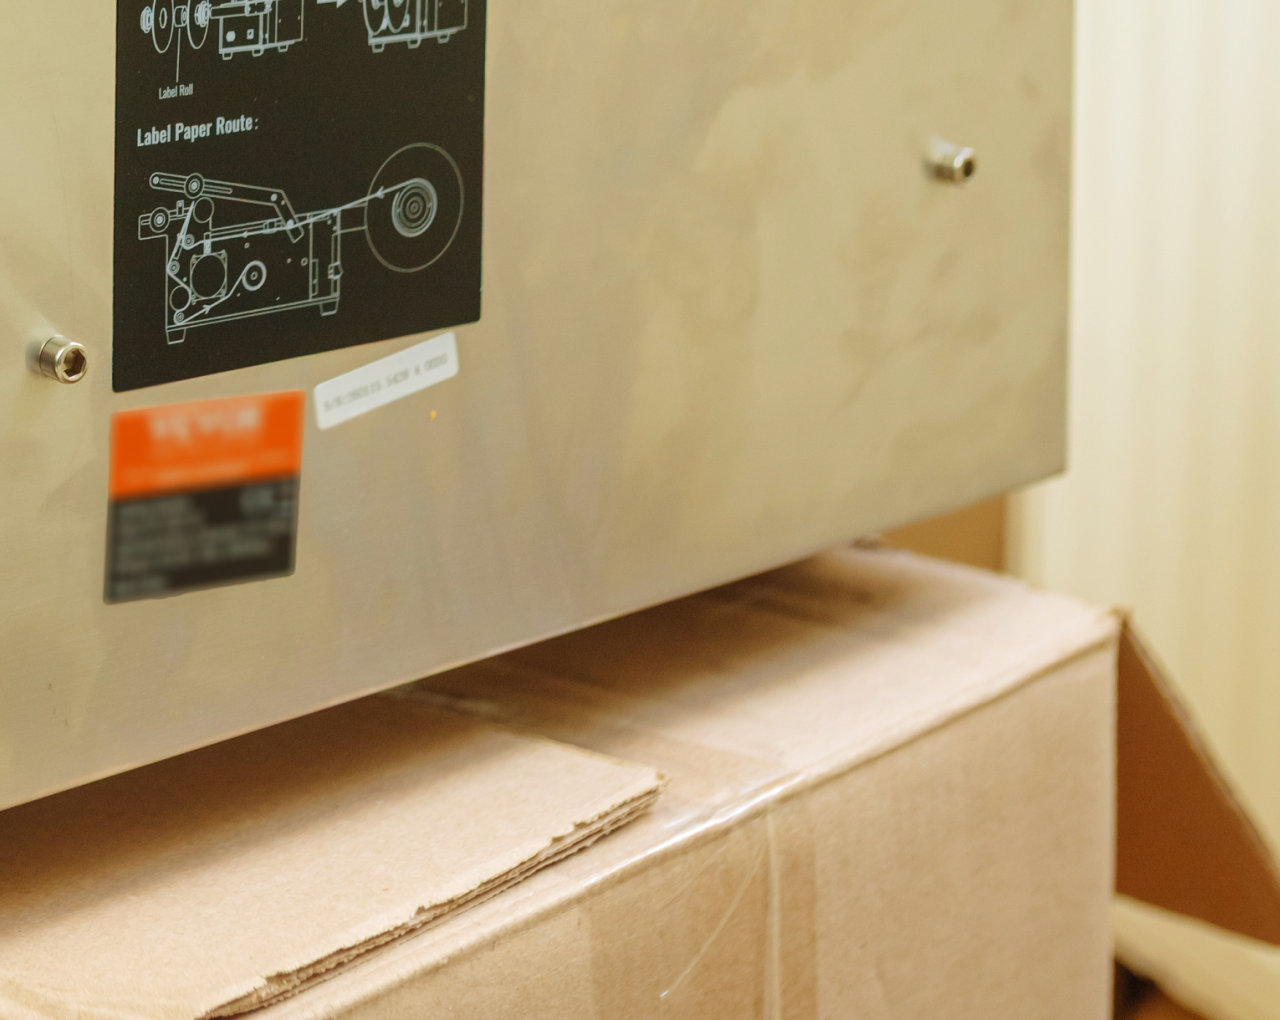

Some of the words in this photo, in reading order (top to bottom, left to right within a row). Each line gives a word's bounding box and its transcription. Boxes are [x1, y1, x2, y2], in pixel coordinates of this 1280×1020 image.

[159, 86, 177, 99] Label
[180, 84, 193, 96] Roll
[137, 124, 171, 146] Label
[175, 123, 212, 142] Paper
